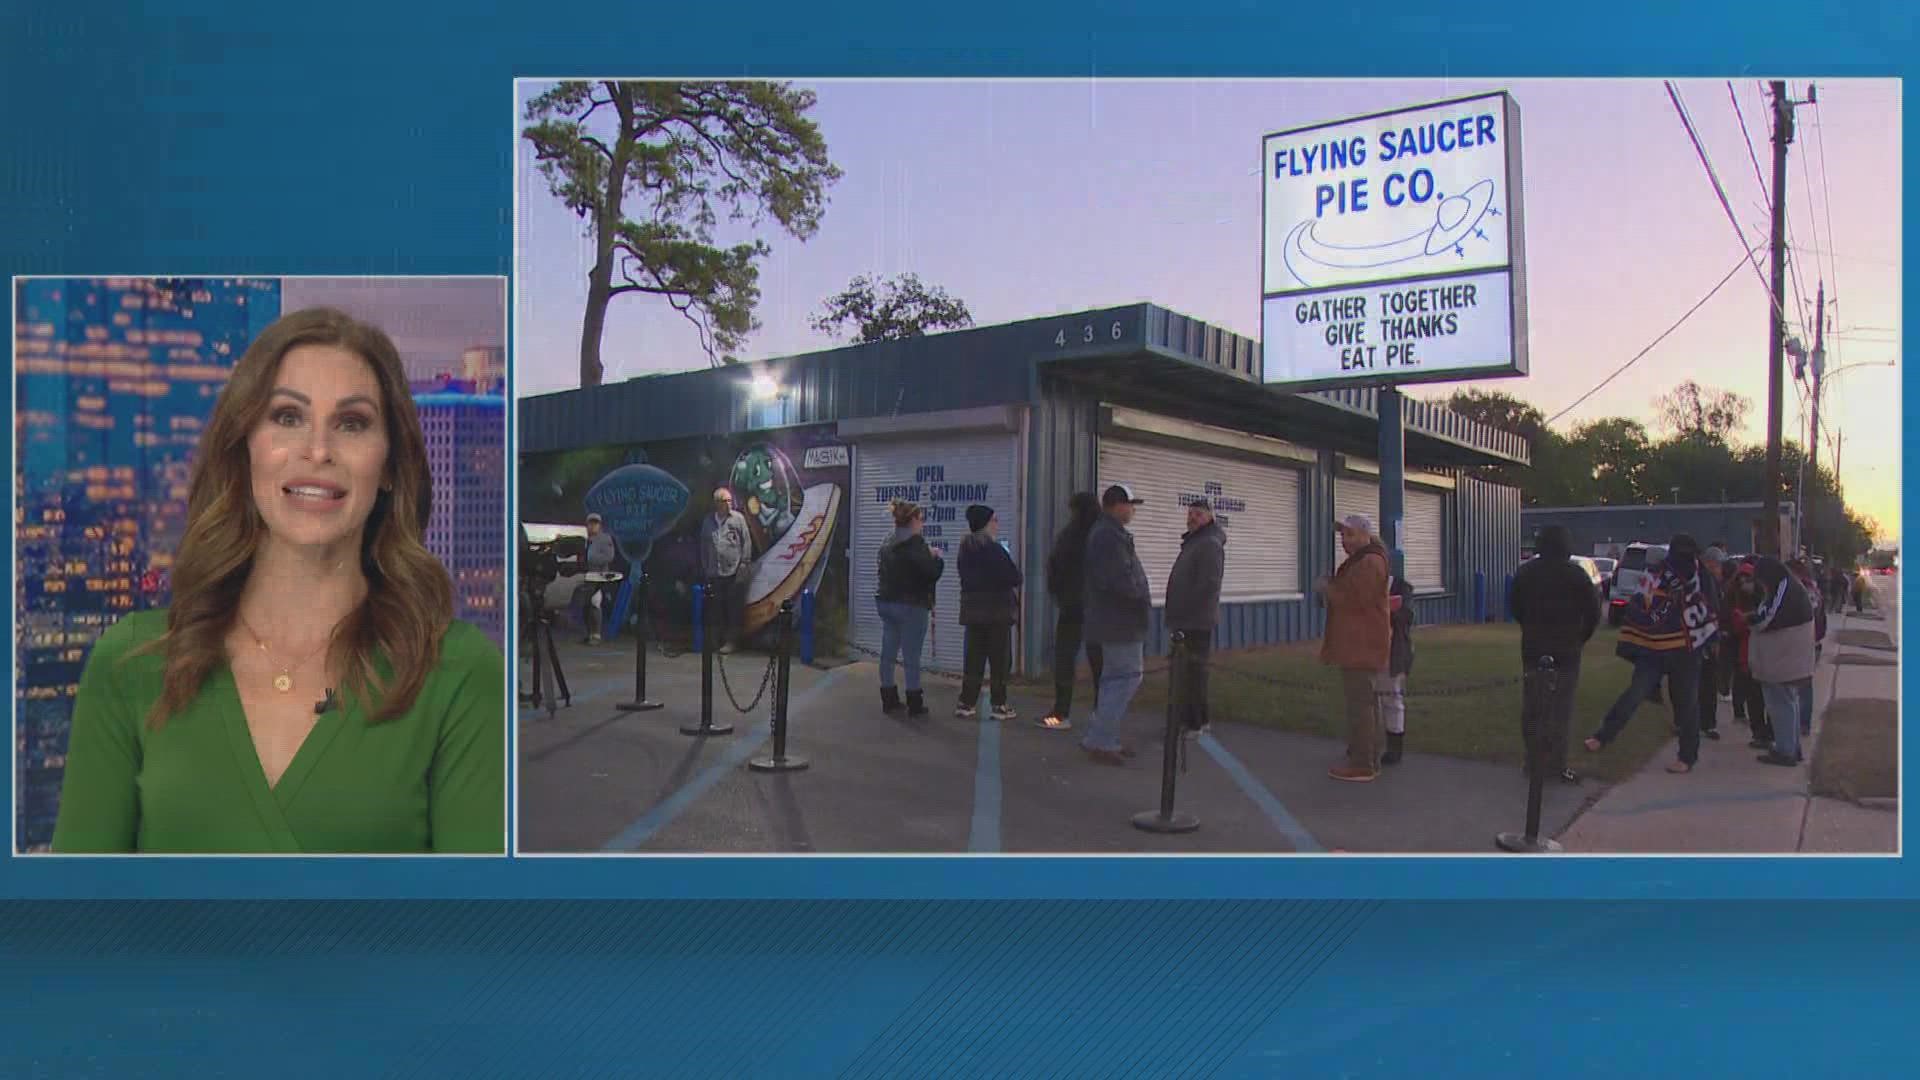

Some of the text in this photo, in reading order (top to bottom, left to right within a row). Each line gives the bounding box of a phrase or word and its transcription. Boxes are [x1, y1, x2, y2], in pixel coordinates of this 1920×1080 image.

[1274, 114, 1497, 179] FLYING SAUCER
[1316, 167, 1444, 218] PIE CO.
[1295, 284, 1477, 324] GATHER TOGETHER
[1325, 312, 1458, 346] GIVE THANKS
[1341, 343, 1421, 370] EAT PIE.
[915, 465, 945, 483] OPEN
[875, 484, 922, 502] TUESDAY
[929, 483, 989, 502] SATURDAY
